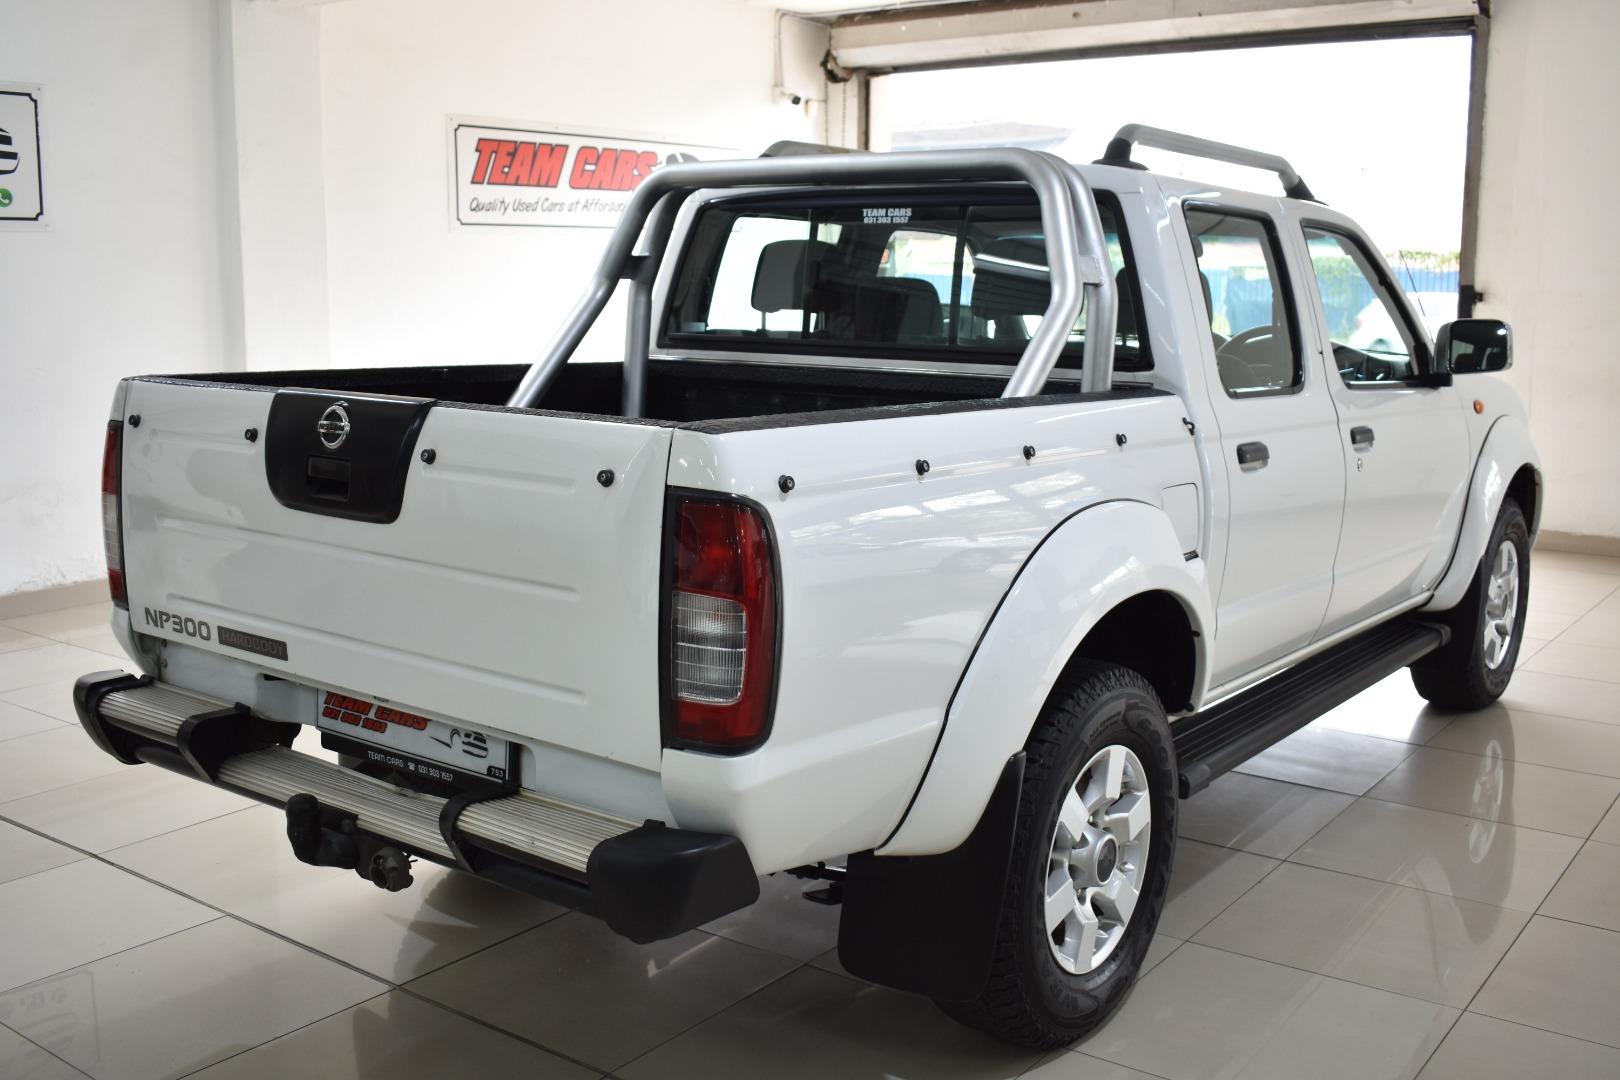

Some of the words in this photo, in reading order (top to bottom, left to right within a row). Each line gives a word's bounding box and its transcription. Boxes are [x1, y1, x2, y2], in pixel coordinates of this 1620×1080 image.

[471, 138, 569, 188] TEAM
[569, 145, 658, 191] CARS
[469, 197, 509, 216] Quality
[512, 197, 538, 212] Used
[541, 197, 565, 213] Cars
[567, 199, 581, 213] at
[863, 208, 887, 217] TEAM
[887, 208, 912, 217] CARS
[863, 216, 877, 224] 031
[877, 216, 892, 224] 303
[892, 216, 909, 224] 1557
[144, 606, 212, 641] NP300
[221, 630, 284, 656] HARDBODY
[323, 690, 373, 716] TEAM
[374, 705, 429, 731] CARS
[367, 750, 386, 763] TEAM
[386, 756, 404, 768] CARS
[417, 765, 428, 774] 031
[429, 767, 440, 778] 303
[441, 771, 454, 782] 1557
[490, 767, 504, 778] 753
